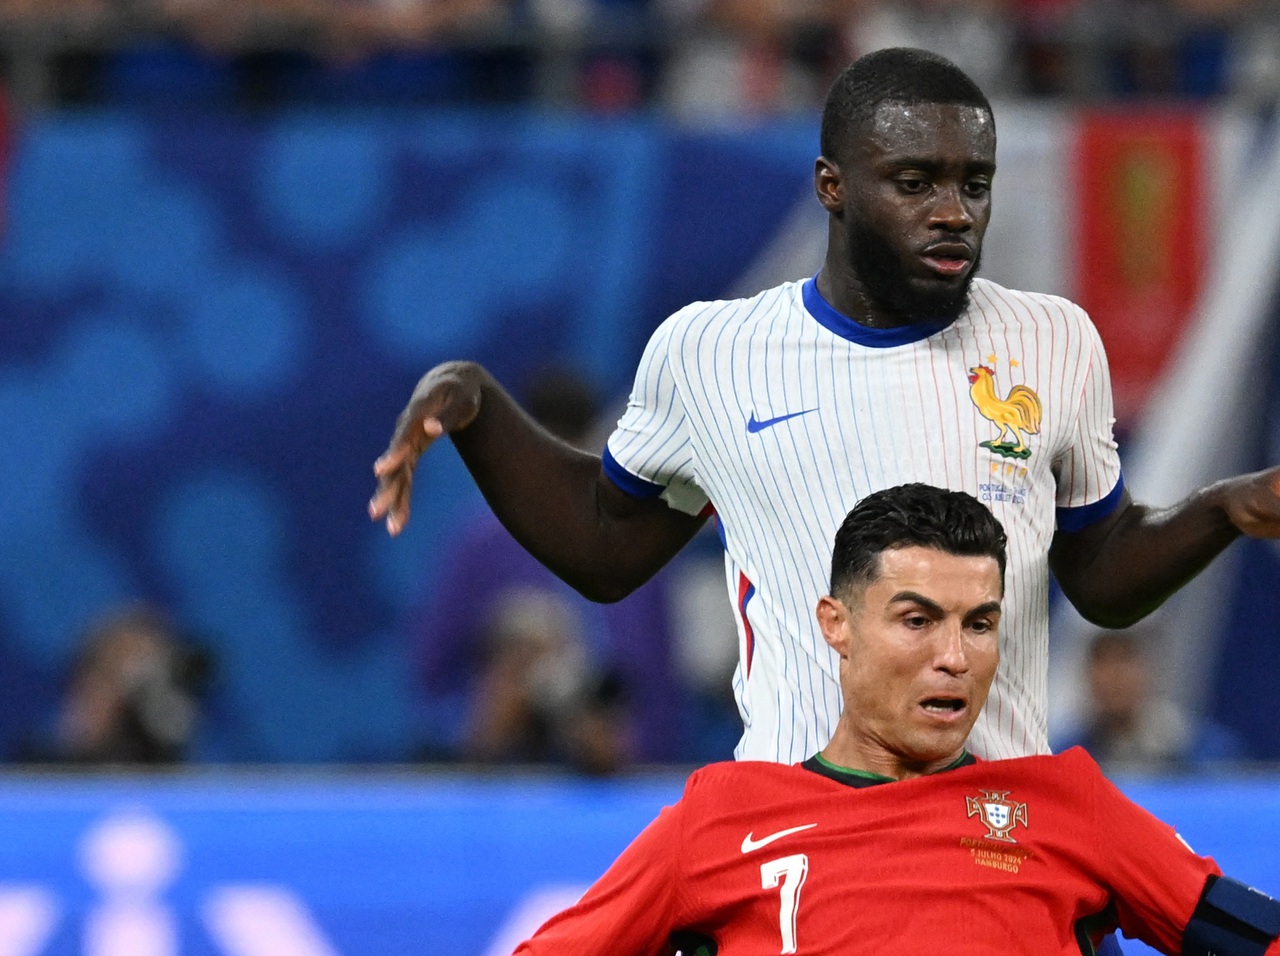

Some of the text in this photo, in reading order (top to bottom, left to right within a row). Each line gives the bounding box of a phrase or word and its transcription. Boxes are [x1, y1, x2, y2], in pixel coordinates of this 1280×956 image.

[978, 849, 1002, 860] JULHO
[974, 857, 1019, 874] HAMBURGO
[760, 853, 809, 955] 7
